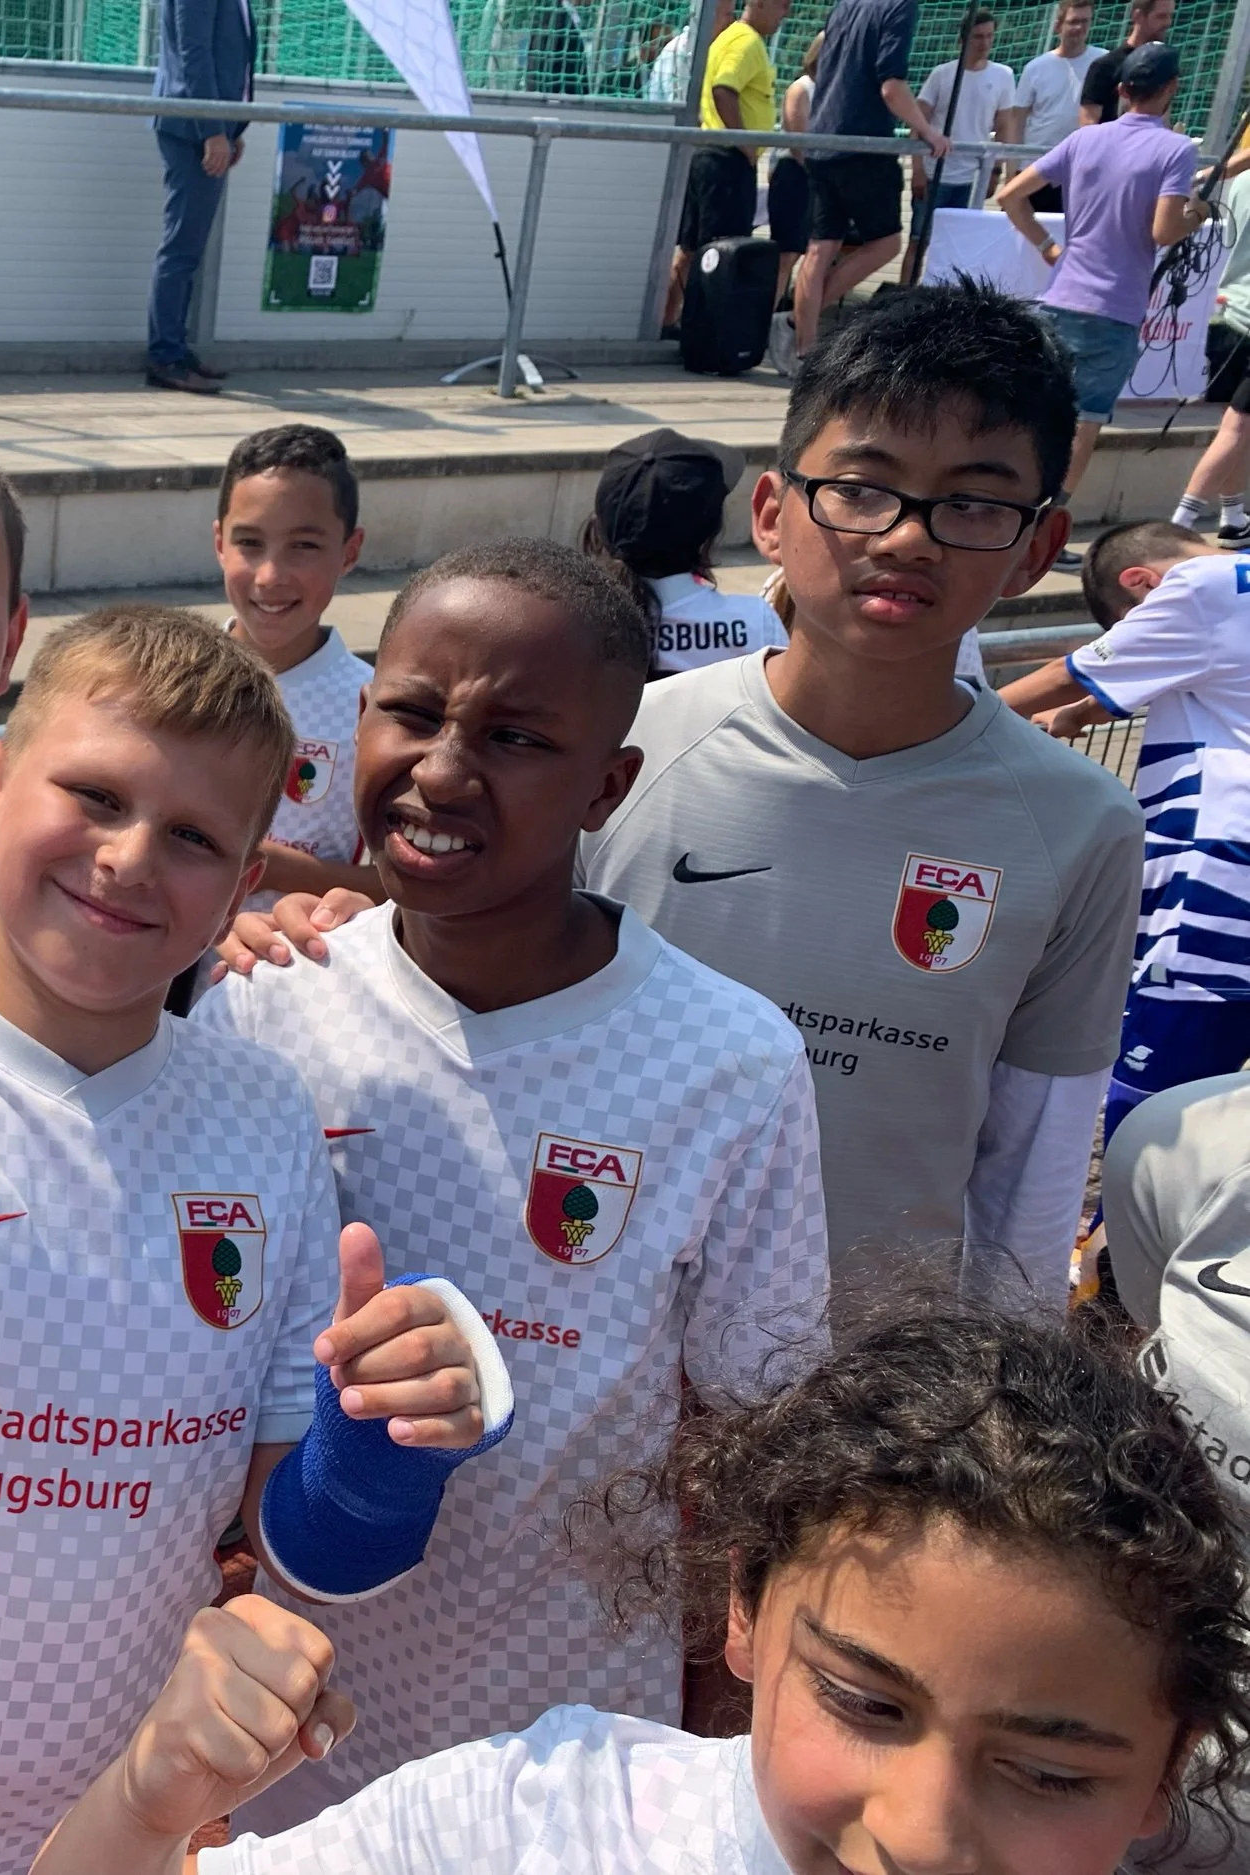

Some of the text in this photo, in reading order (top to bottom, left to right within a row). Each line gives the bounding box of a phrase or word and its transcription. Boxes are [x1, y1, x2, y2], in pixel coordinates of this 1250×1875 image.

[914, 863, 987, 898] FCA
[918, 951, 949, 967] 1907
[546, 1142, 627, 1183] FCA
[185, 1199, 257, 1228] FCA
[556, 1243, 590, 1259] 1907
[215, 1307, 242, 1321] 1907
